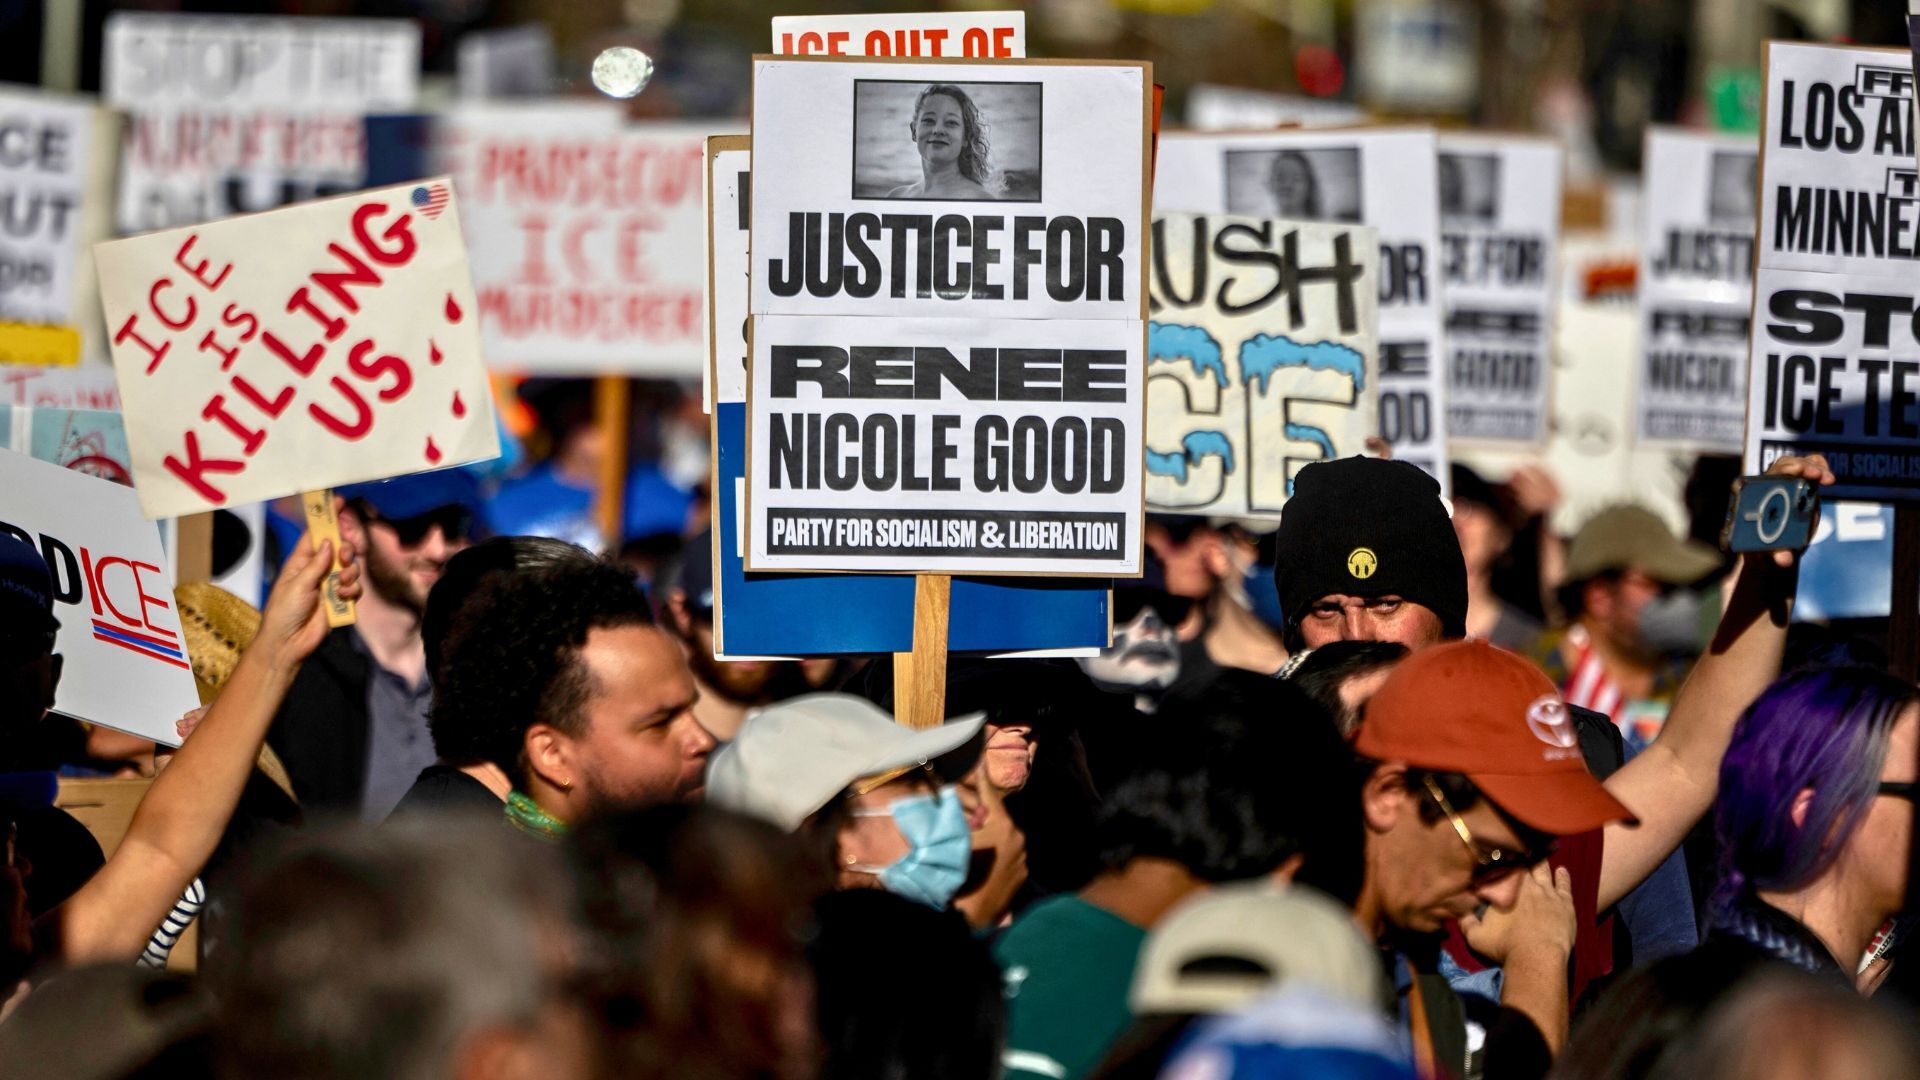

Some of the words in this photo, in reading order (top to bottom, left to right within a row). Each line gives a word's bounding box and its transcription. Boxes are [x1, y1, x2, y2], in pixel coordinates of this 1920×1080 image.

[864, 29, 949, 57] OUT
[962, 27, 1015, 58] OF
[1780, 79, 1865, 154] LOS
[768, 211, 1005, 300] JUSTICE
[1013, 215, 1125, 301] FOR
[1150, 217, 1363, 335] USH
[114, 234, 234, 376] ICE
[198, 303, 260, 372] IS
[1766, 289, 1920, 349] ST
[162, 201, 418, 505] KILLING
[308, 338, 414, 441] US
[769, 344, 1127, 403] RENEE
[1764, 353, 1847, 435] ICE
[769, 411, 961, 492] NICOLE
[973, 414, 1126, 494] GOOD
[772, 518, 833, 547] PARTY
[836, 518, 873, 548] FOR
[876, 519, 977, 549] SOCIALISM
[980, 521, 1006, 549] &
[1009, 522, 1119, 551] LIBERATION
